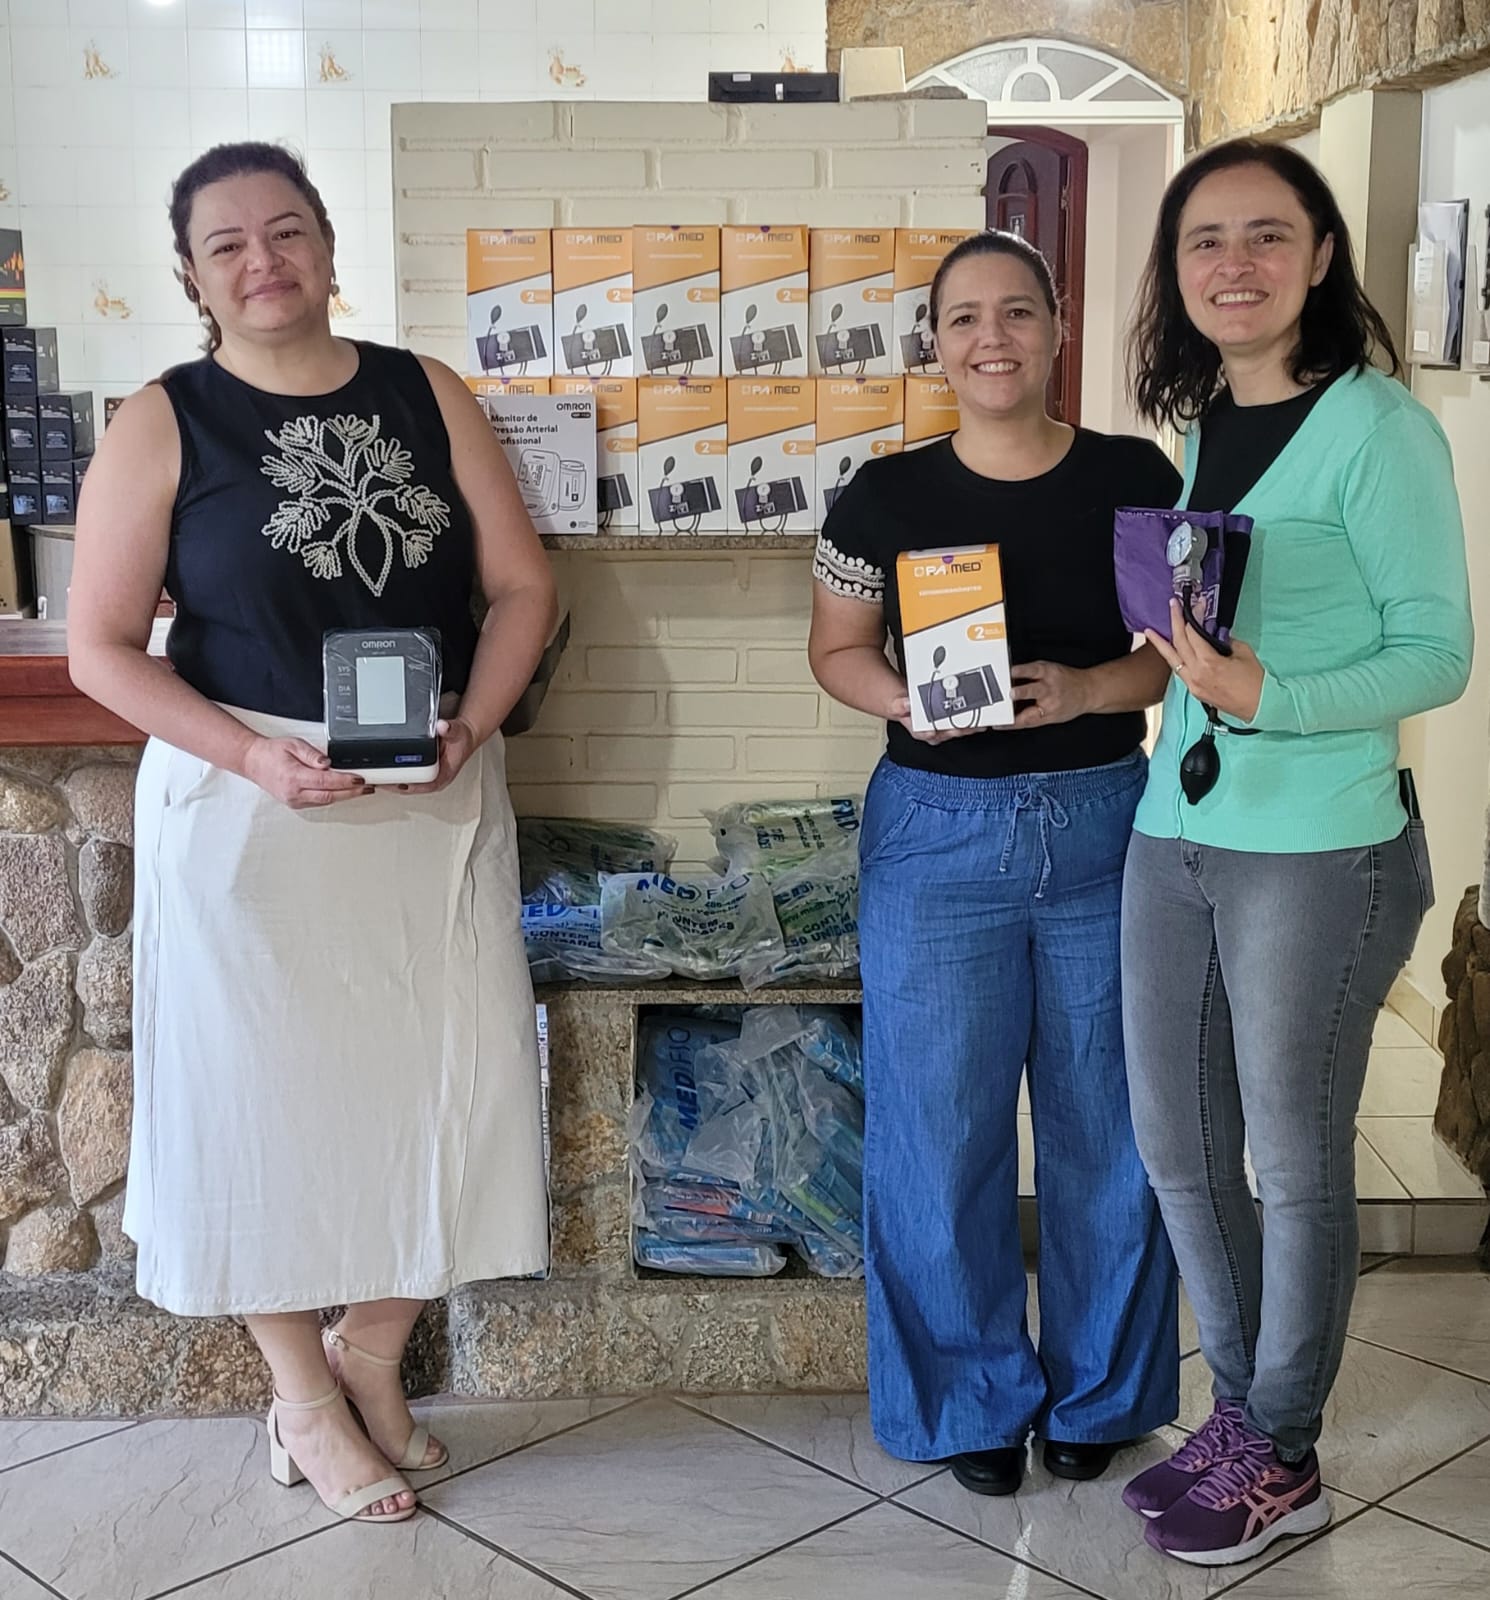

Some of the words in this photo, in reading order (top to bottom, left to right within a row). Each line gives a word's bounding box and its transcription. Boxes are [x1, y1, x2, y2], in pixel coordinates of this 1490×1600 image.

[527, 291, 535, 302] 2
[612, 290, 621, 300] 2
[693, 290, 702, 300] 2
[783, 290, 792, 300] 2
[868, 290, 877, 300] 2
[491, 414, 525, 423] Monitor
[527, 413, 538, 422] de
[526, 424, 558, 433] Arterial
[500, 436, 541, 445] ofissional
[701, 443, 710, 453] 2
[788, 442, 798, 453] 2
[877, 443, 886, 453] 2
[951, 561, 981, 574] MED
[975, 626, 985, 640] 2
